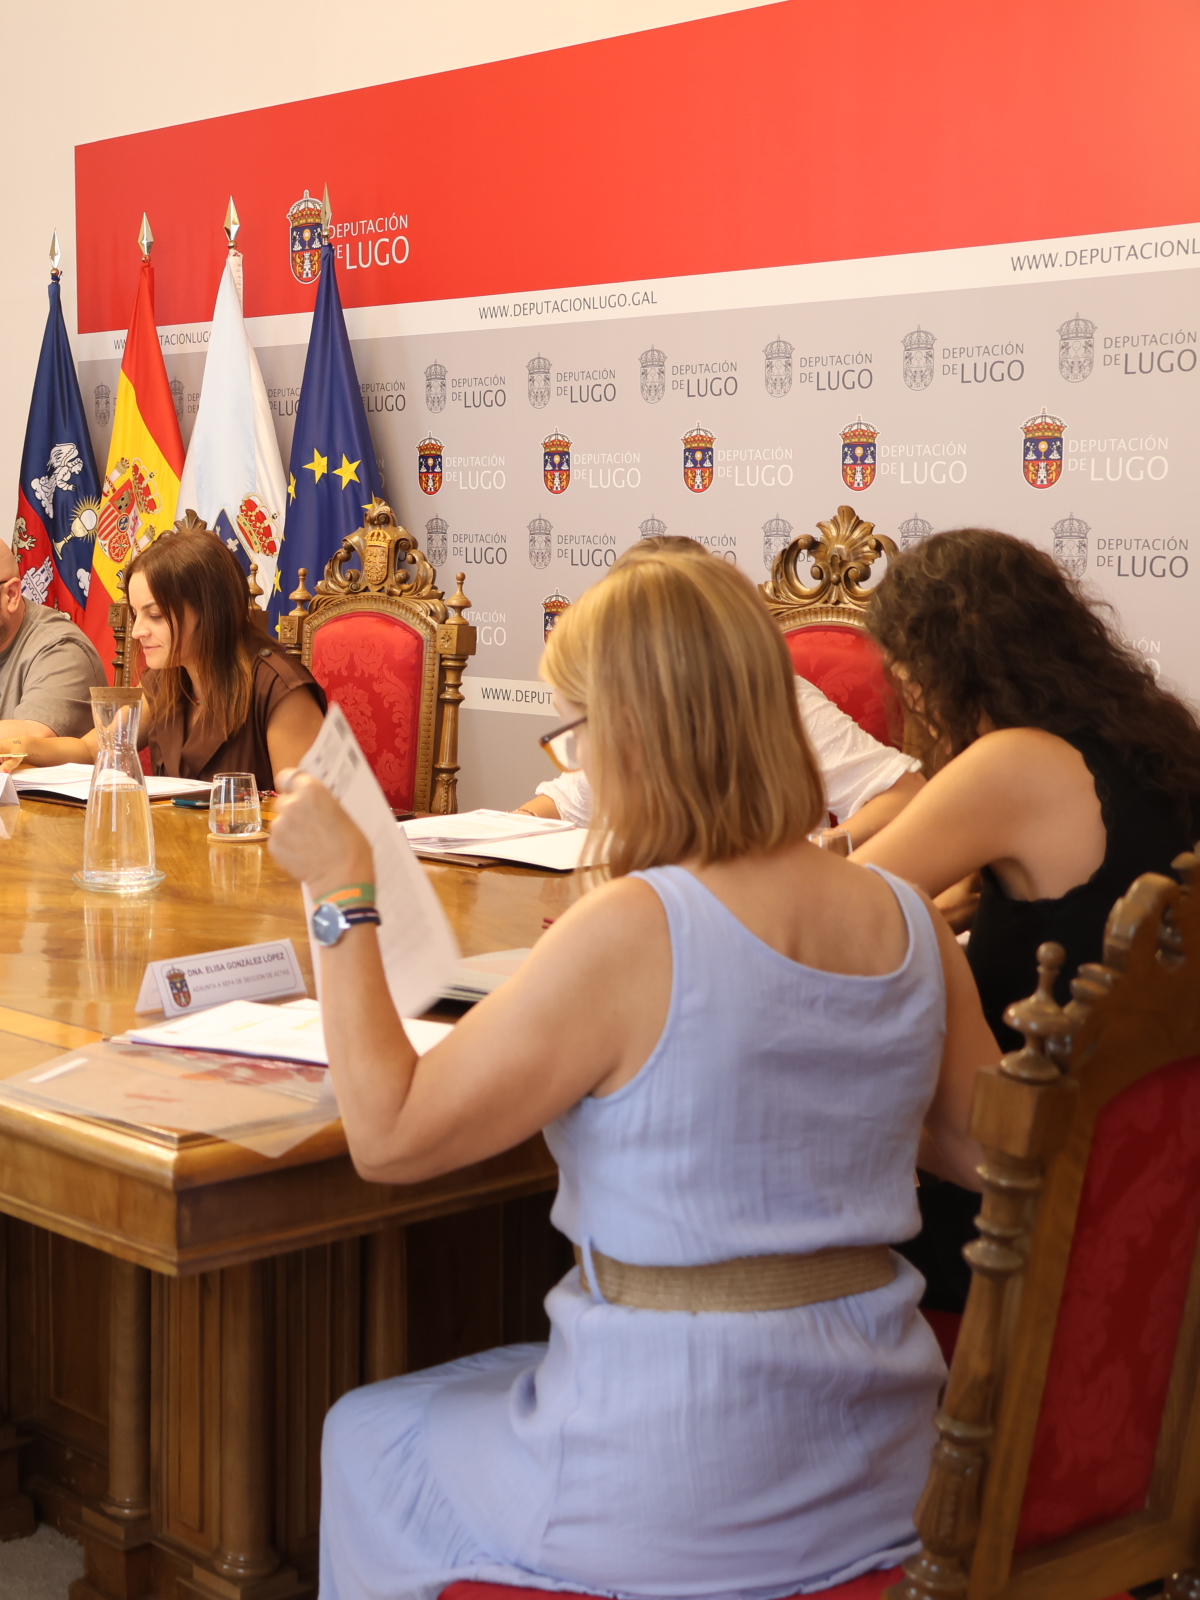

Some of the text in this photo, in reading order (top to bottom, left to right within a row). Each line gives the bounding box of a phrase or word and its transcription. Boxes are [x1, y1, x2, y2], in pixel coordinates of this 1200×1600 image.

[329, 213, 408, 239] DEPUTACIÓN
[346, 236, 410, 270] LUGO
[479, 290, 657, 320] WWW.DEPUTACIONLUGO.GAL
[1103, 329, 1198, 349] DEPUTACIÓN
[800, 351, 873, 368] DEPUTACIÓN
[942, 341, 1025, 359] DEPUTACIÓN
[671, 359, 738, 377] DEPUTACIÓN
[1103, 348, 1198, 375] DE LUGO
[451, 374, 506, 388] DEPUTACIÓN
[556, 367, 616, 382] DEPUTACIÓN
[800, 368, 873, 391] DE LUGO
[942, 359, 1025, 384] DE LUGO
[268, 387, 300, 398] DEPUTAC
[361, 380, 406, 393] EPUTACIÓN
[556, 383, 617, 403] DE LUGO
[671, 375, 738, 397] DE LUGO
[367, 394, 406, 413] LUGO
[451, 389, 506, 408] DE LUGO
[717, 446, 793, 462] DEPUTACIÓN
[881, 441, 967, 458] DEPUTACIÓN
[1068, 435, 1168, 454] DEPUTACIÓN
[445, 453, 505, 468] DEPUTACIÓN
[573, 450, 641, 465] DEPUTACIÓN
[573, 466, 641, 488] DE LUGO
[717, 463, 793, 487] DE LUGO
[881, 459, 967, 484] DE LUGO
[1068, 455, 1168, 482] DE LUGO
[445, 470, 506, 490] DE LUGO
[453, 532, 507, 544] DEPUTACIÓN
[557, 533, 616, 545] DEPUTACIÓN
[1097, 536, 1189, 551] DEPUTACIÓN
[453, 546, 507, 565] DE LUGO
[557, 548, 617, 567] DE LUGO
[1097, 555, 1189, 578] DE LUGO
[481, 687, 553, 705] WWW.DEPUT
[187, 952, 285, 977] DNA. ELISA GONZÁLEZ LÓPEZ
